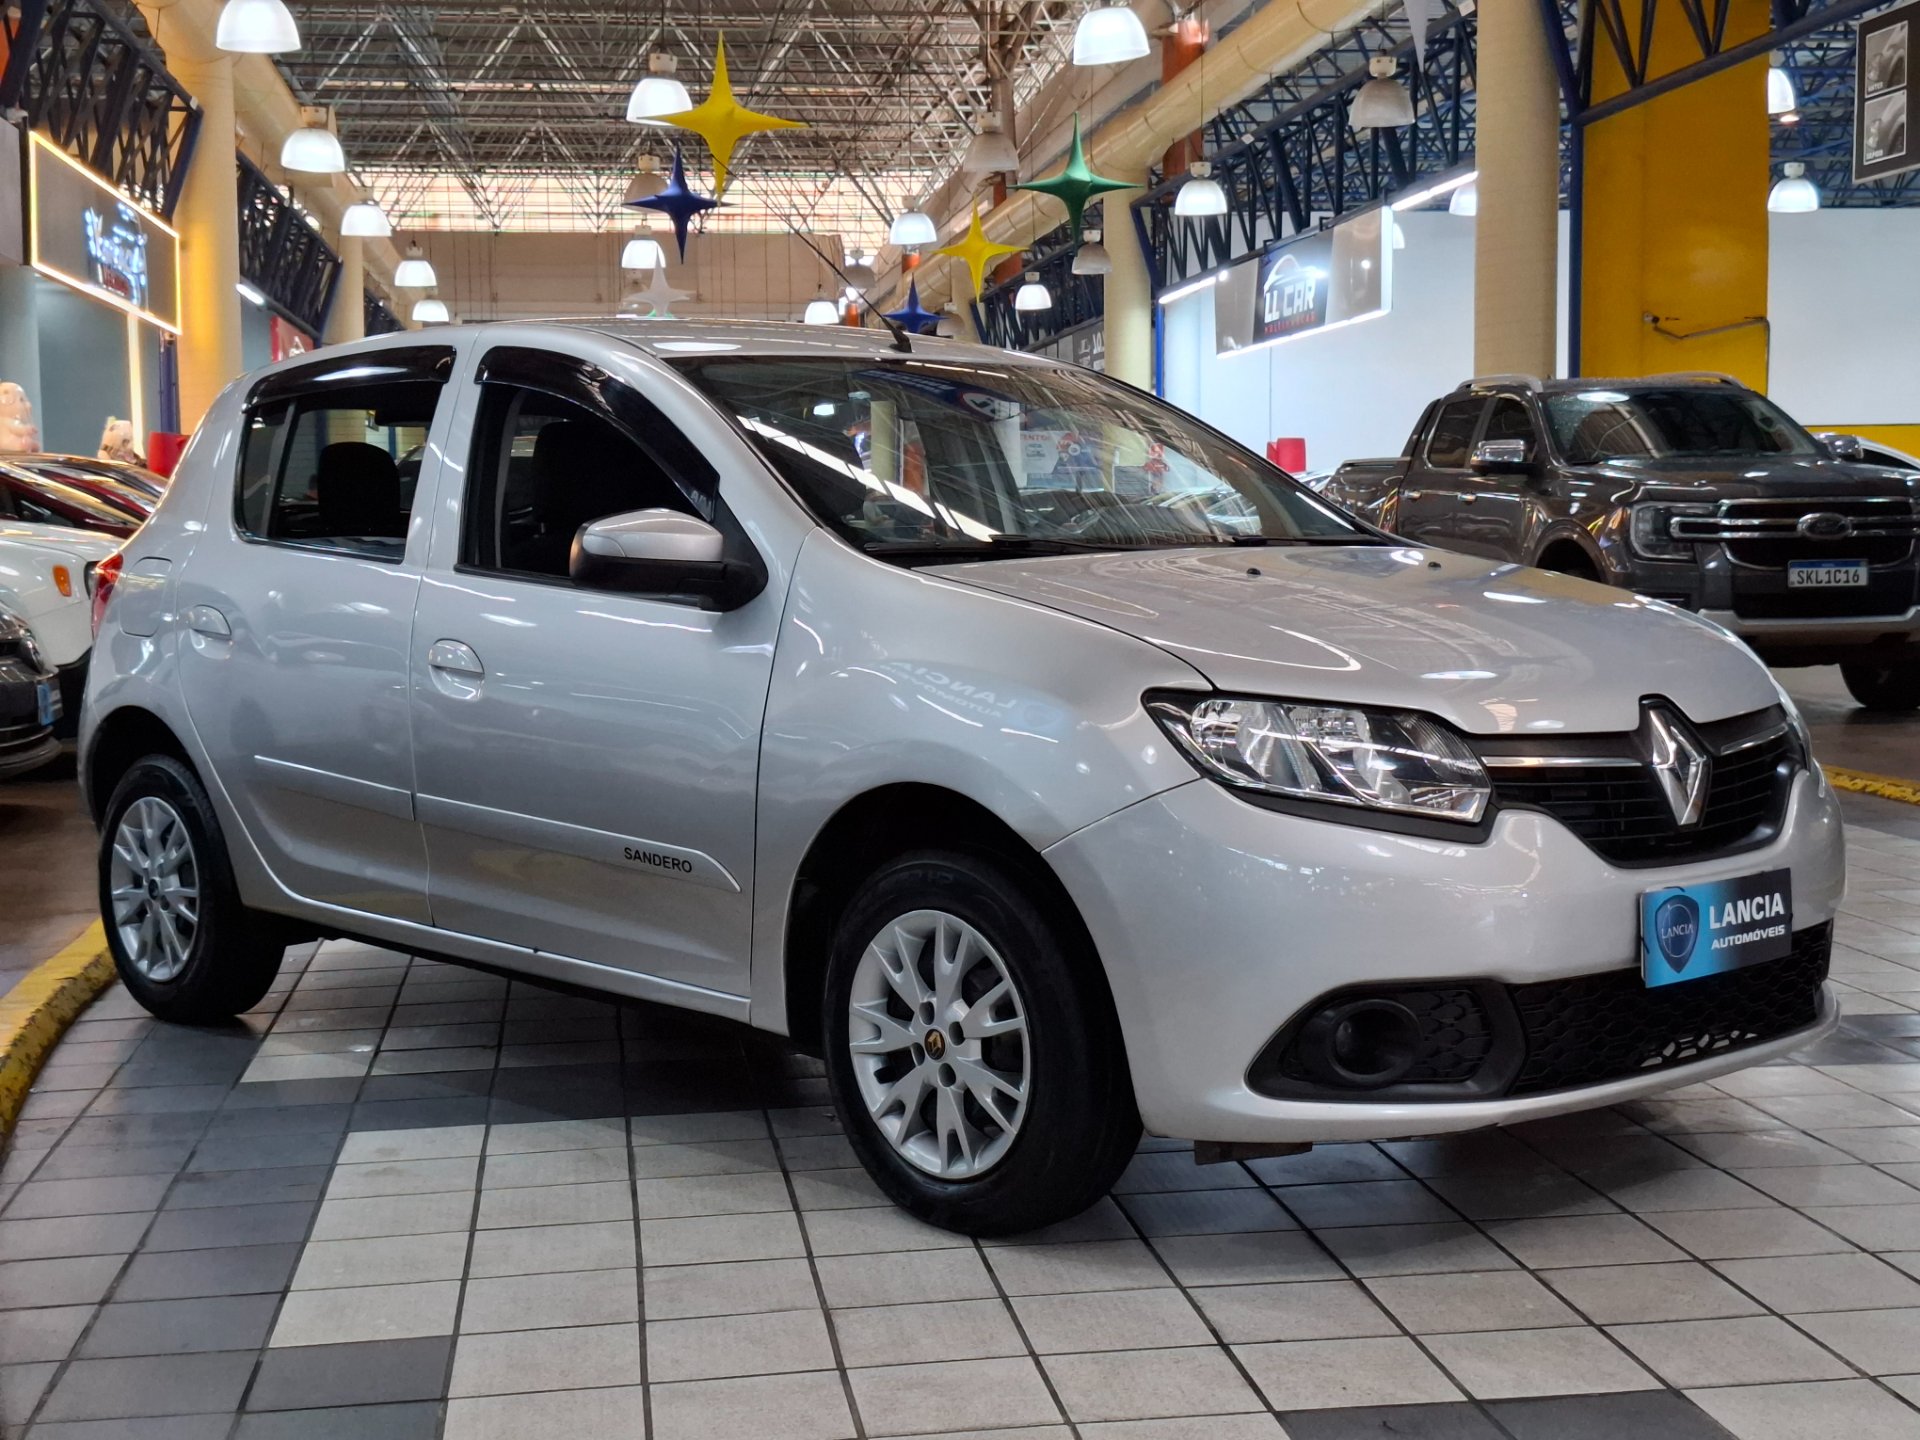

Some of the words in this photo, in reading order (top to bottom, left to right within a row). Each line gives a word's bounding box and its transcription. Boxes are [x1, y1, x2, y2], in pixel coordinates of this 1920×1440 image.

[1283, 277, 1317, 317] CAR
[1796, 569, 1860, 585] SKL1C16
[624, 846, 693, 873] SANDERO
[1709, 892, 1785, 930] LANCIA
[1661, 923, 1694, 939] LANCIA
[1711, 924, 1786, 950] AUTOMÓVEIS
